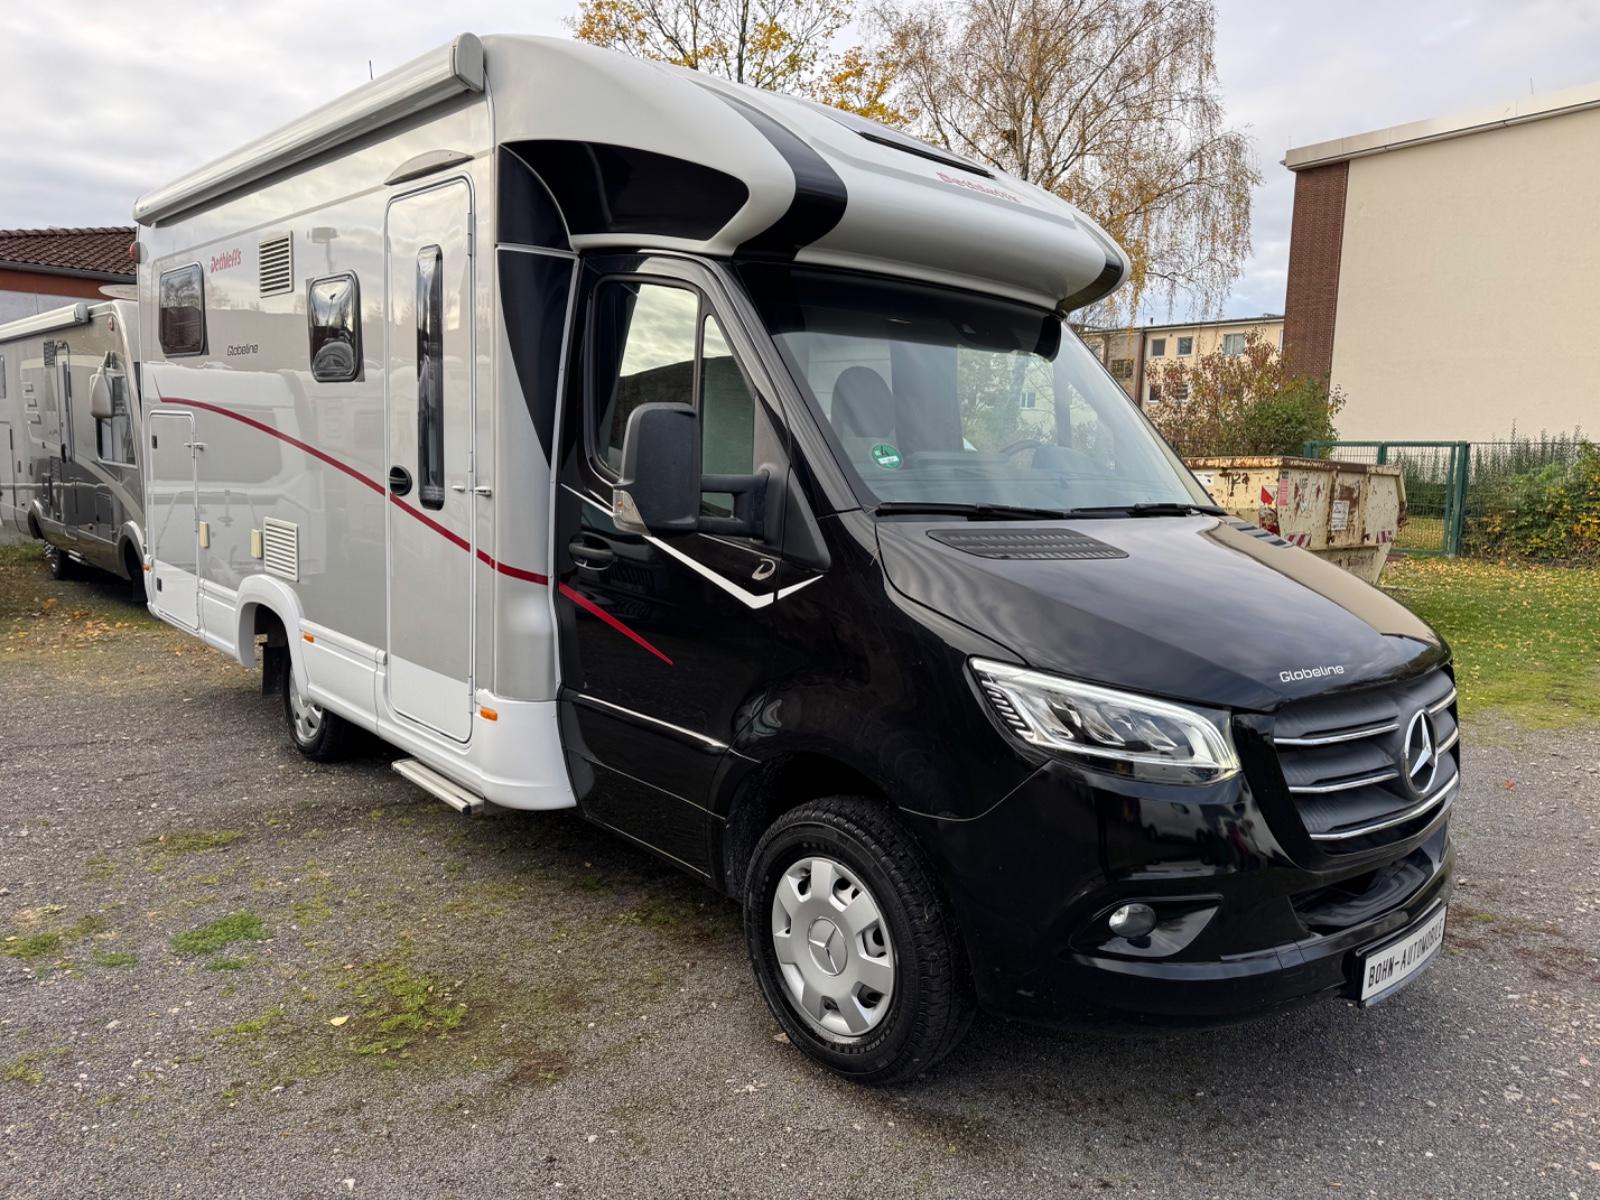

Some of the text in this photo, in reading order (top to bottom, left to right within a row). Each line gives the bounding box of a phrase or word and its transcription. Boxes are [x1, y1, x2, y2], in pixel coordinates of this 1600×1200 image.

[210, 248, 241, 273] Dethleffs
[227, 344, 258, 356] Globeline
[1279, 665, 1345, 683] Globeline
